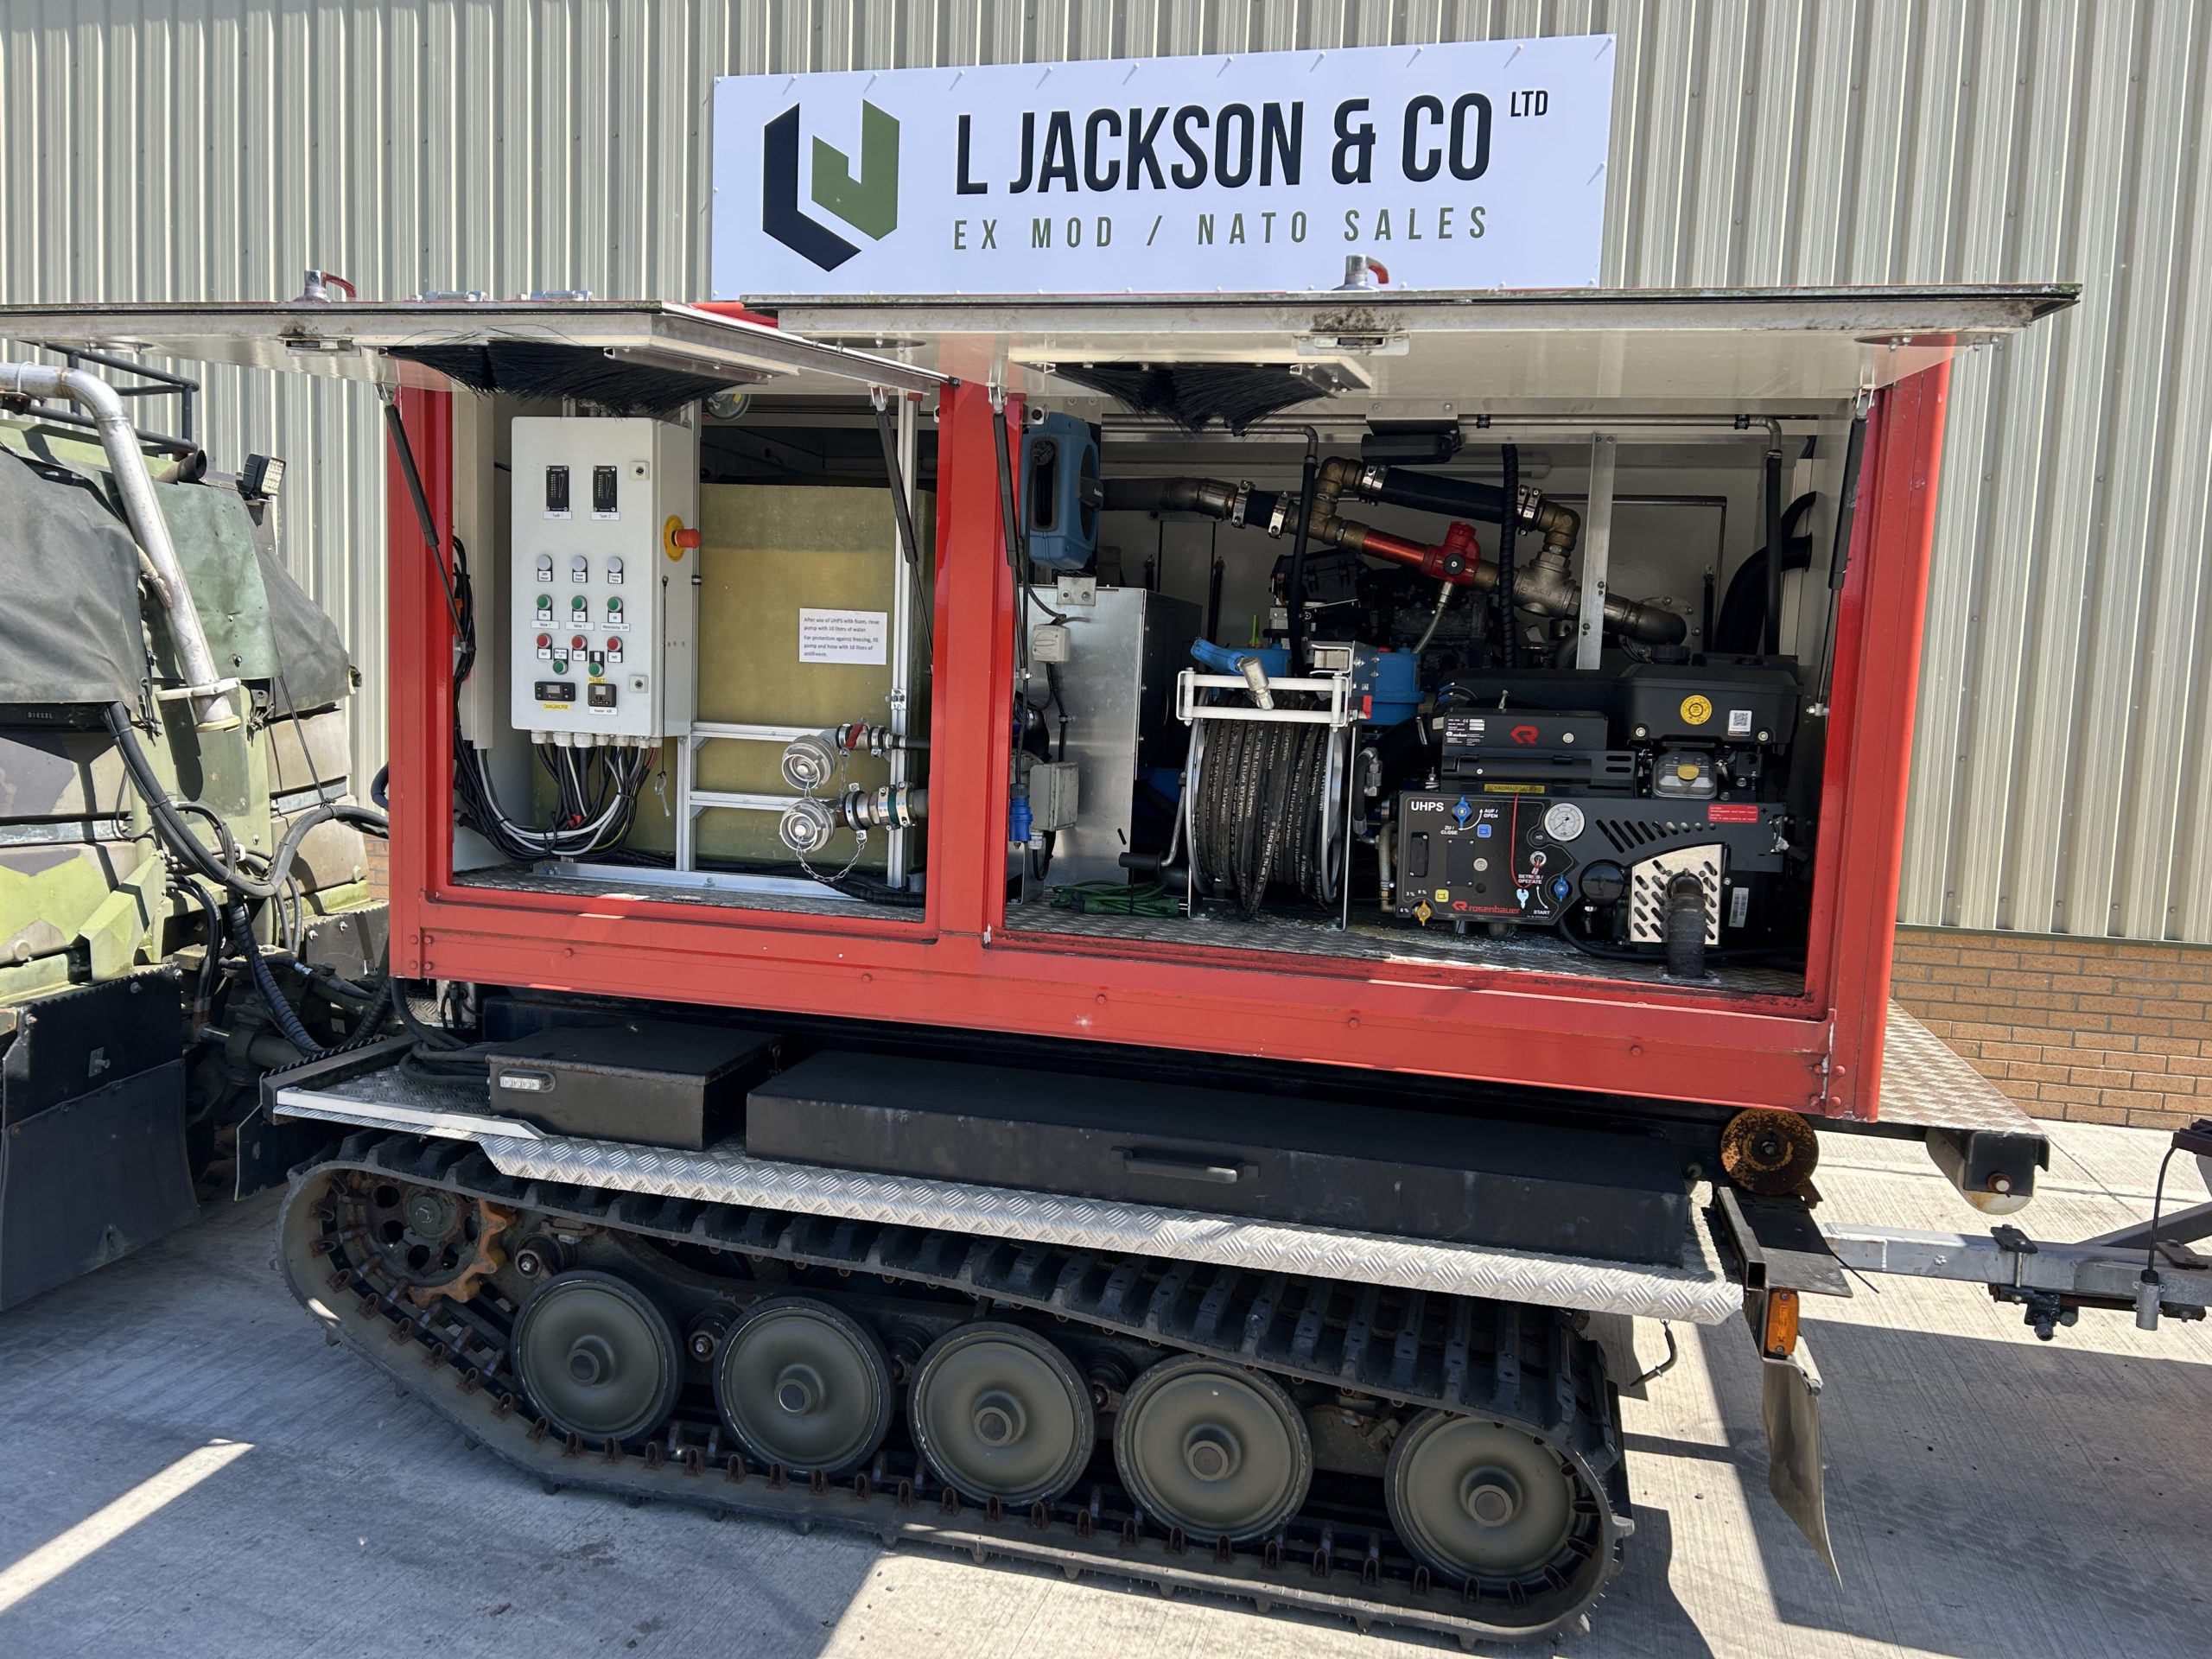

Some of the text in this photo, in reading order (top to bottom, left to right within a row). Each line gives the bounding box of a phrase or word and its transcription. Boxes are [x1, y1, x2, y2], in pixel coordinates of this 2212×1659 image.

[957, 90, 1548, 194] L JACKSON & CO LTD
[954, 206, 1486, 250] EX MOD / NATO SALES
[1246, 781, 1255, 817] HANSA-FLEX
[1411, 801, 1445, 812] UHPS
[1469, 905, 1522, 914] rosenbauer
